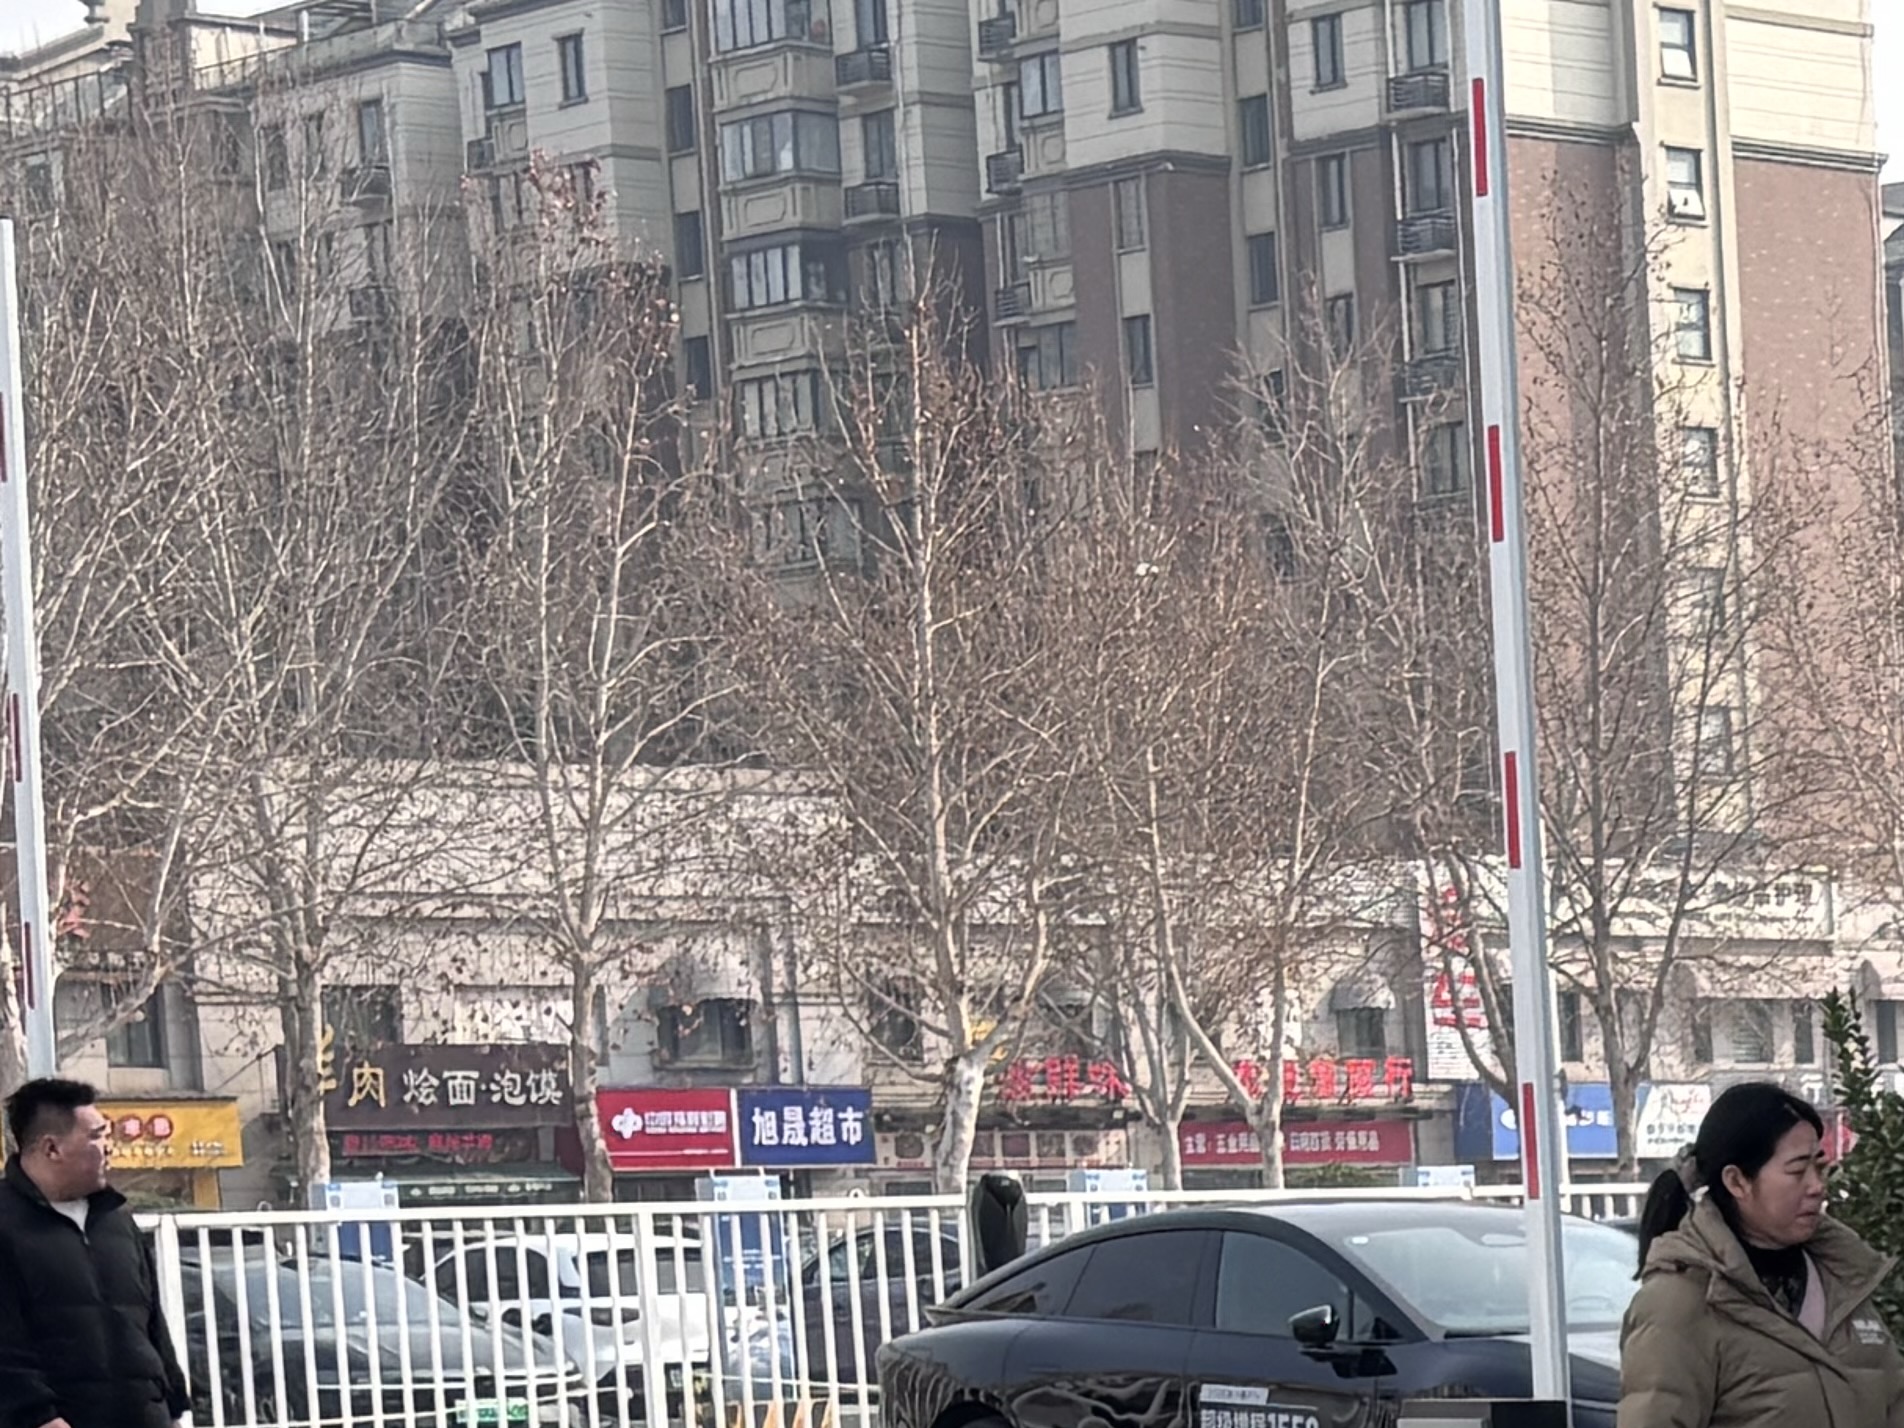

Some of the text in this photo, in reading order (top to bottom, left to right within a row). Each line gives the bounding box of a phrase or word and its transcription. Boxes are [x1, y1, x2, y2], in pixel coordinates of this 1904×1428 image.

[402, 1067, 563, 1106] 烩面·泡馍
[752, 1106, 865, 1146] 旭晟超市
